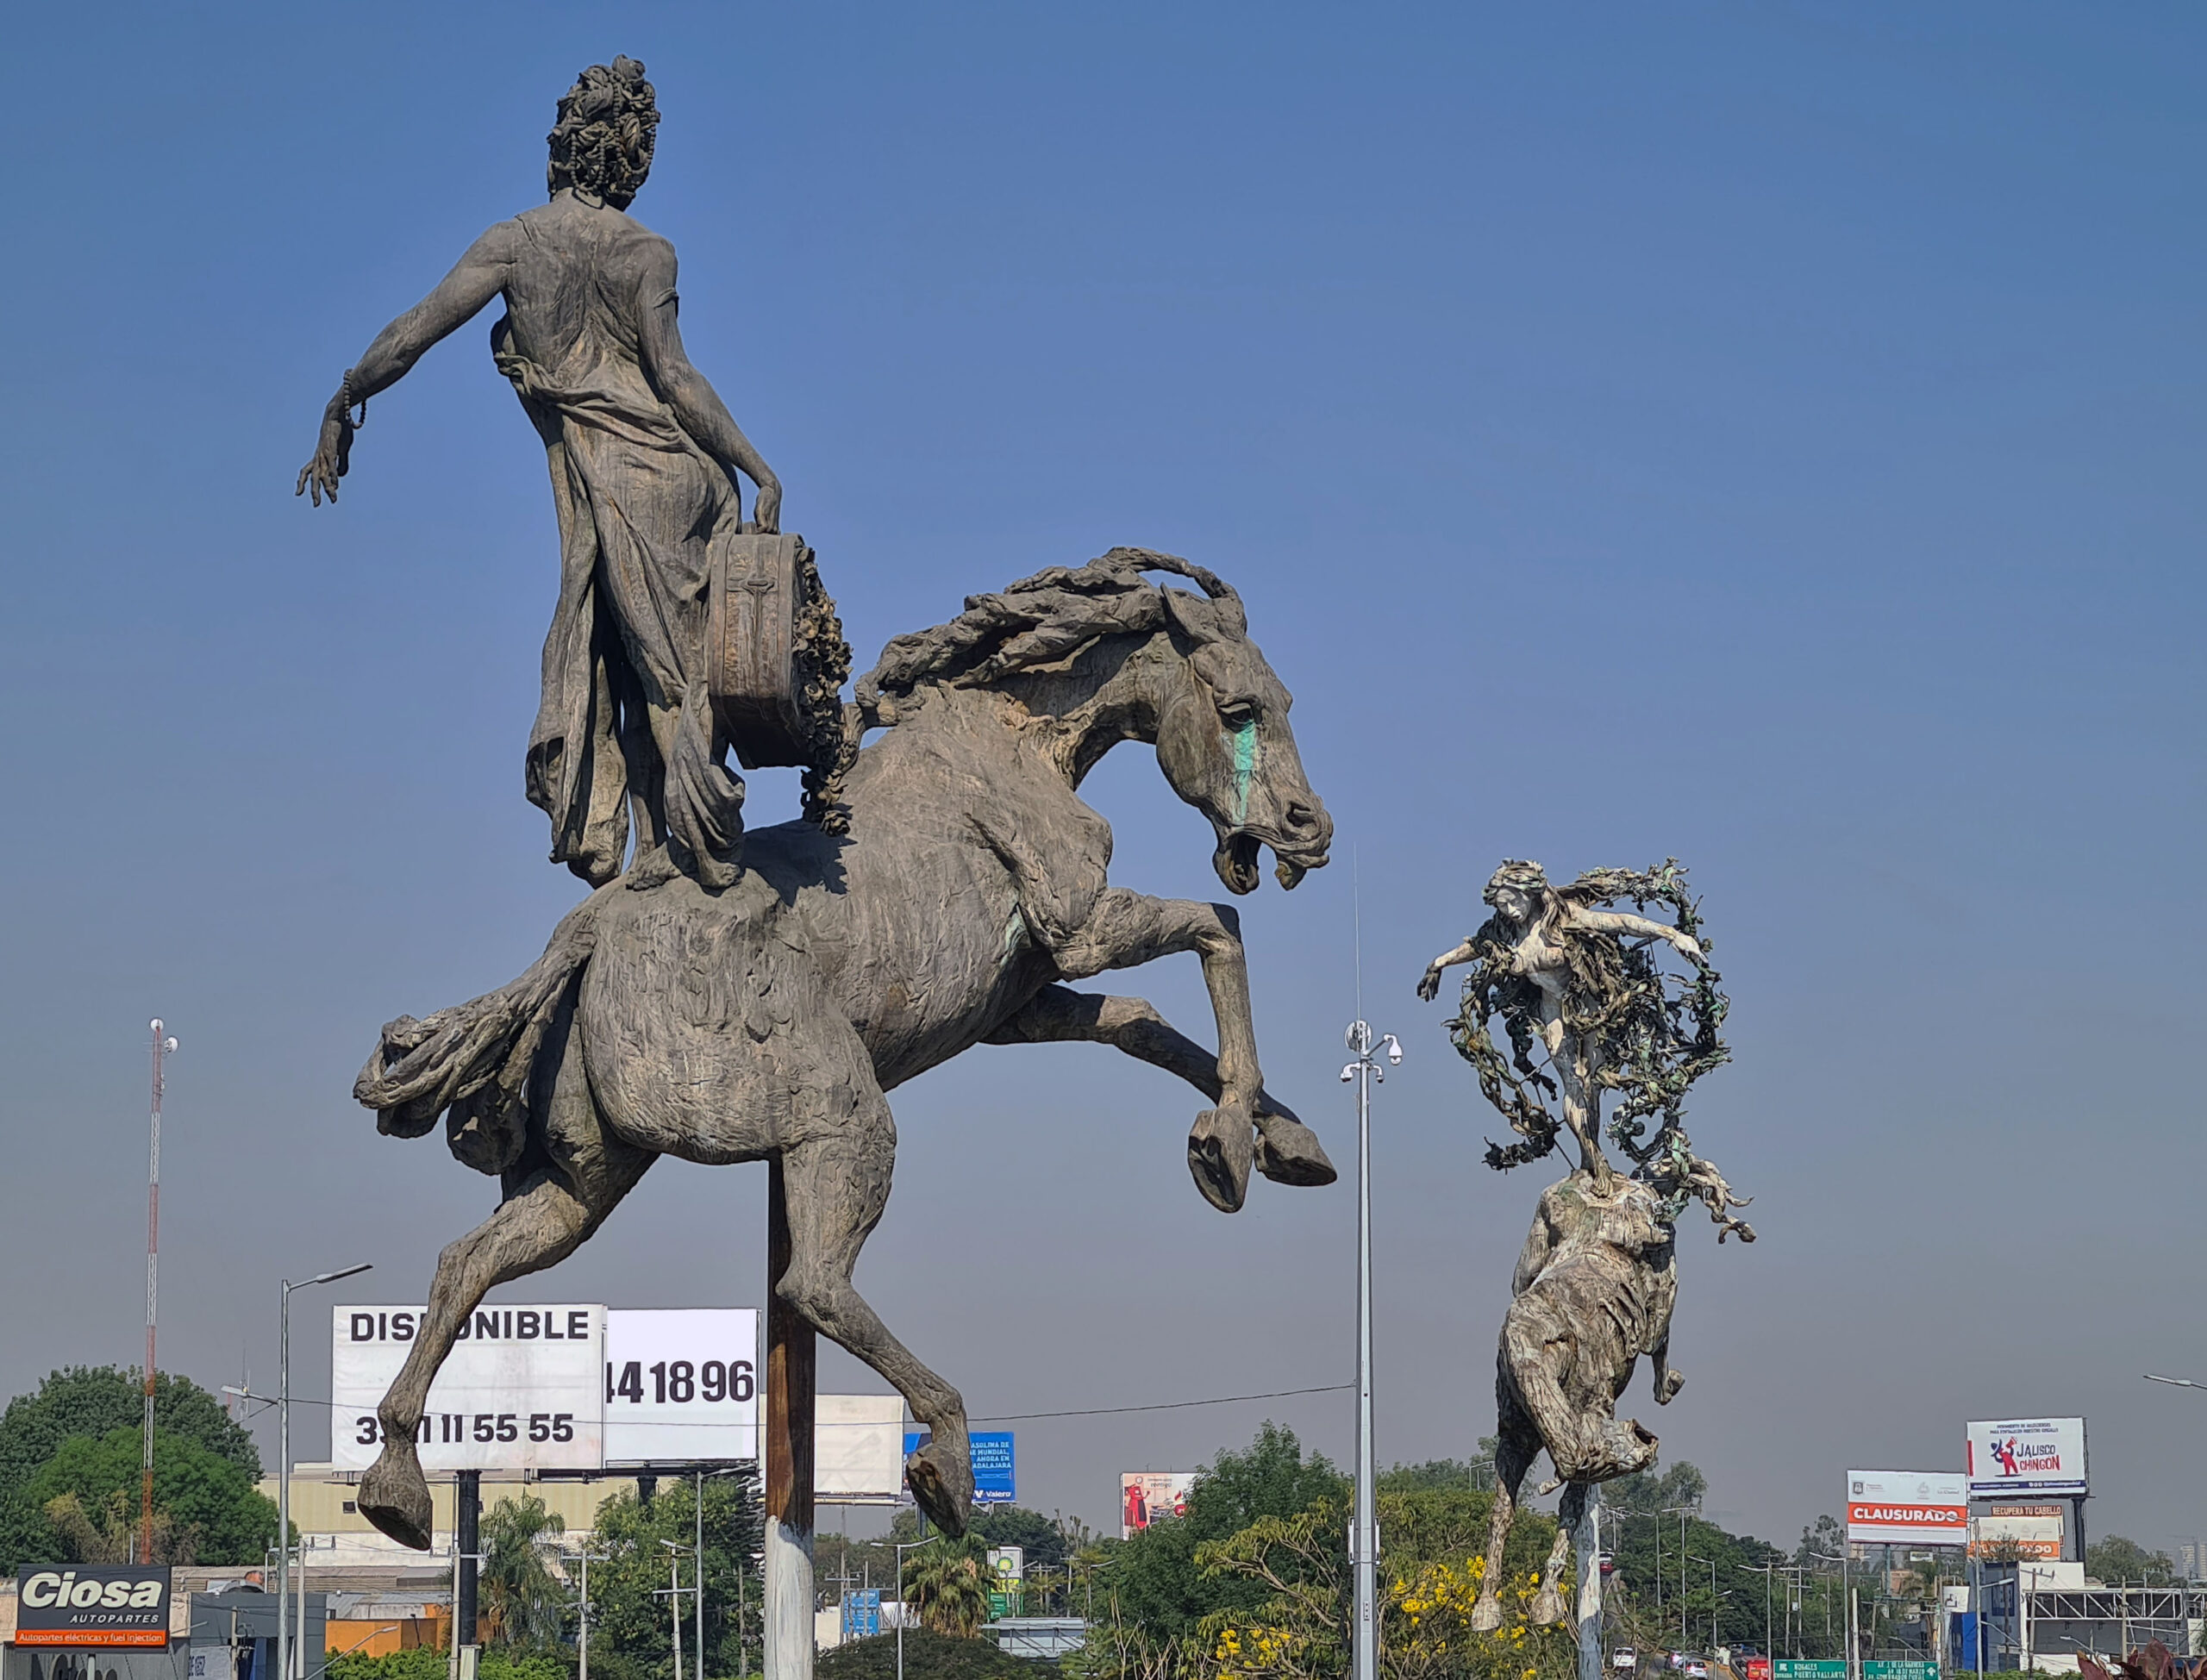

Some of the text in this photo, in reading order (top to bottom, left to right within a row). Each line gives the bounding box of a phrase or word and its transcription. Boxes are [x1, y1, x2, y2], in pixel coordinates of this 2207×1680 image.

[351, 1311, 589, 1341] DISNIBLE
[649, 1360, 695, 1403] 18
[701, 1360, 754, 1402] 96
[356, 1416, 388, 1445] 3
[473, 1414, 518, 1443] 55
[528, 1414, 573, 1443] 55
[2016, 1443, 2056, 1458] JALISCO
[986, 1490, 1012, 1498] Valero
[1854, 1507, 1958, 1522] CLAUSURADO
[1992, 1506, 2061, 1515] RECUPERA TU CABELLO
[22, 1571, 163, 1608] Ciosa
[70, 1614, 159, 1624] AUTOPARTES
[19, 1633, 63, 1642] Autopartes
[103, 1634, 109, 1643] y
[110, 1633, 125, 1642] fuel
